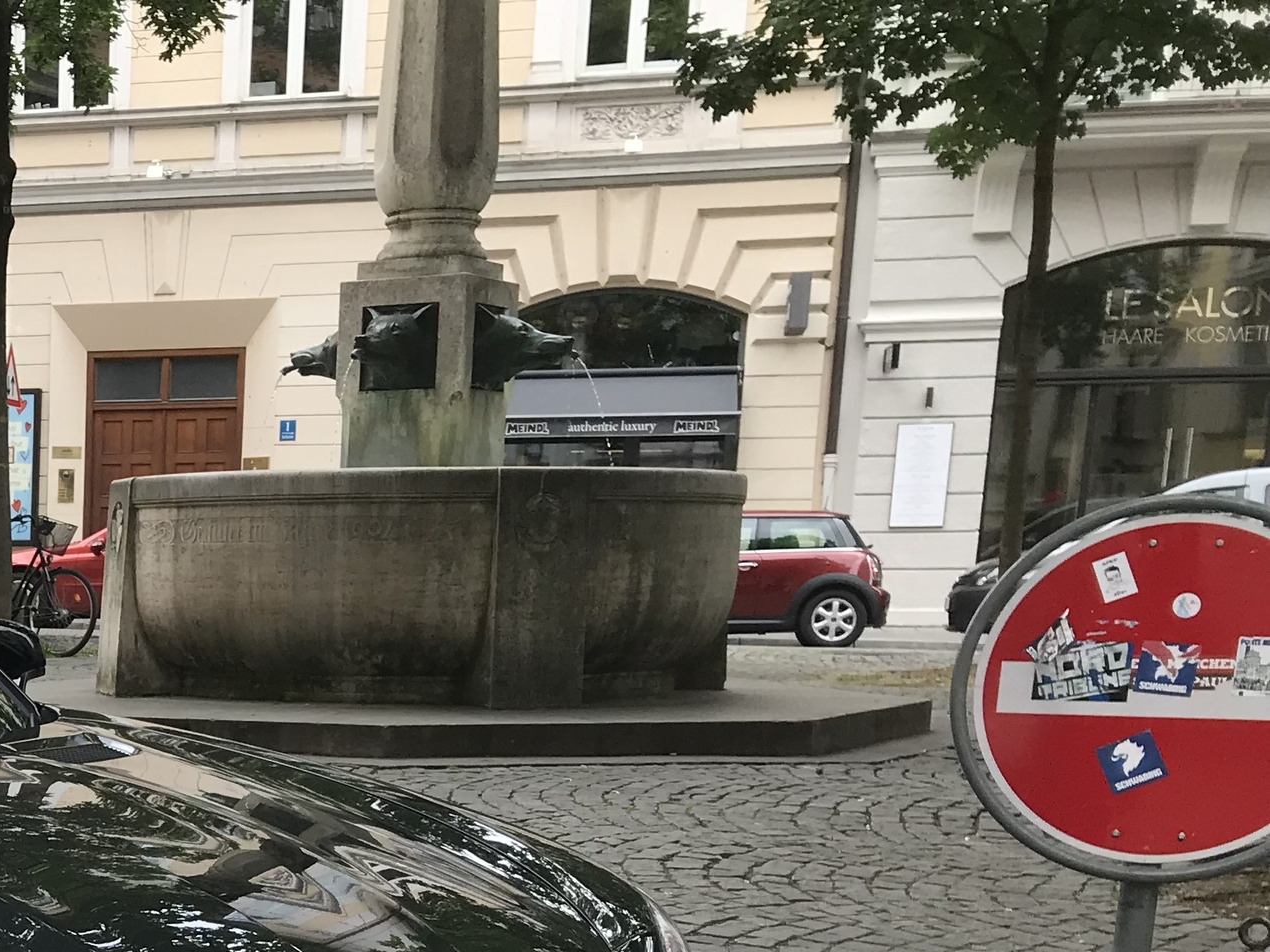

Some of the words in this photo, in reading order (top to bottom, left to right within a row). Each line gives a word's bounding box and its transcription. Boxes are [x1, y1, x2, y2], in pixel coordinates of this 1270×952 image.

[1102, 326, 1164, 345] HAARE
[505, 421, 550, 436] MEINDL
[567, 421, 618, 433] authentic
[620, 420, 657, 434] luxury
[673, 420, 720, 434] MEINDL
